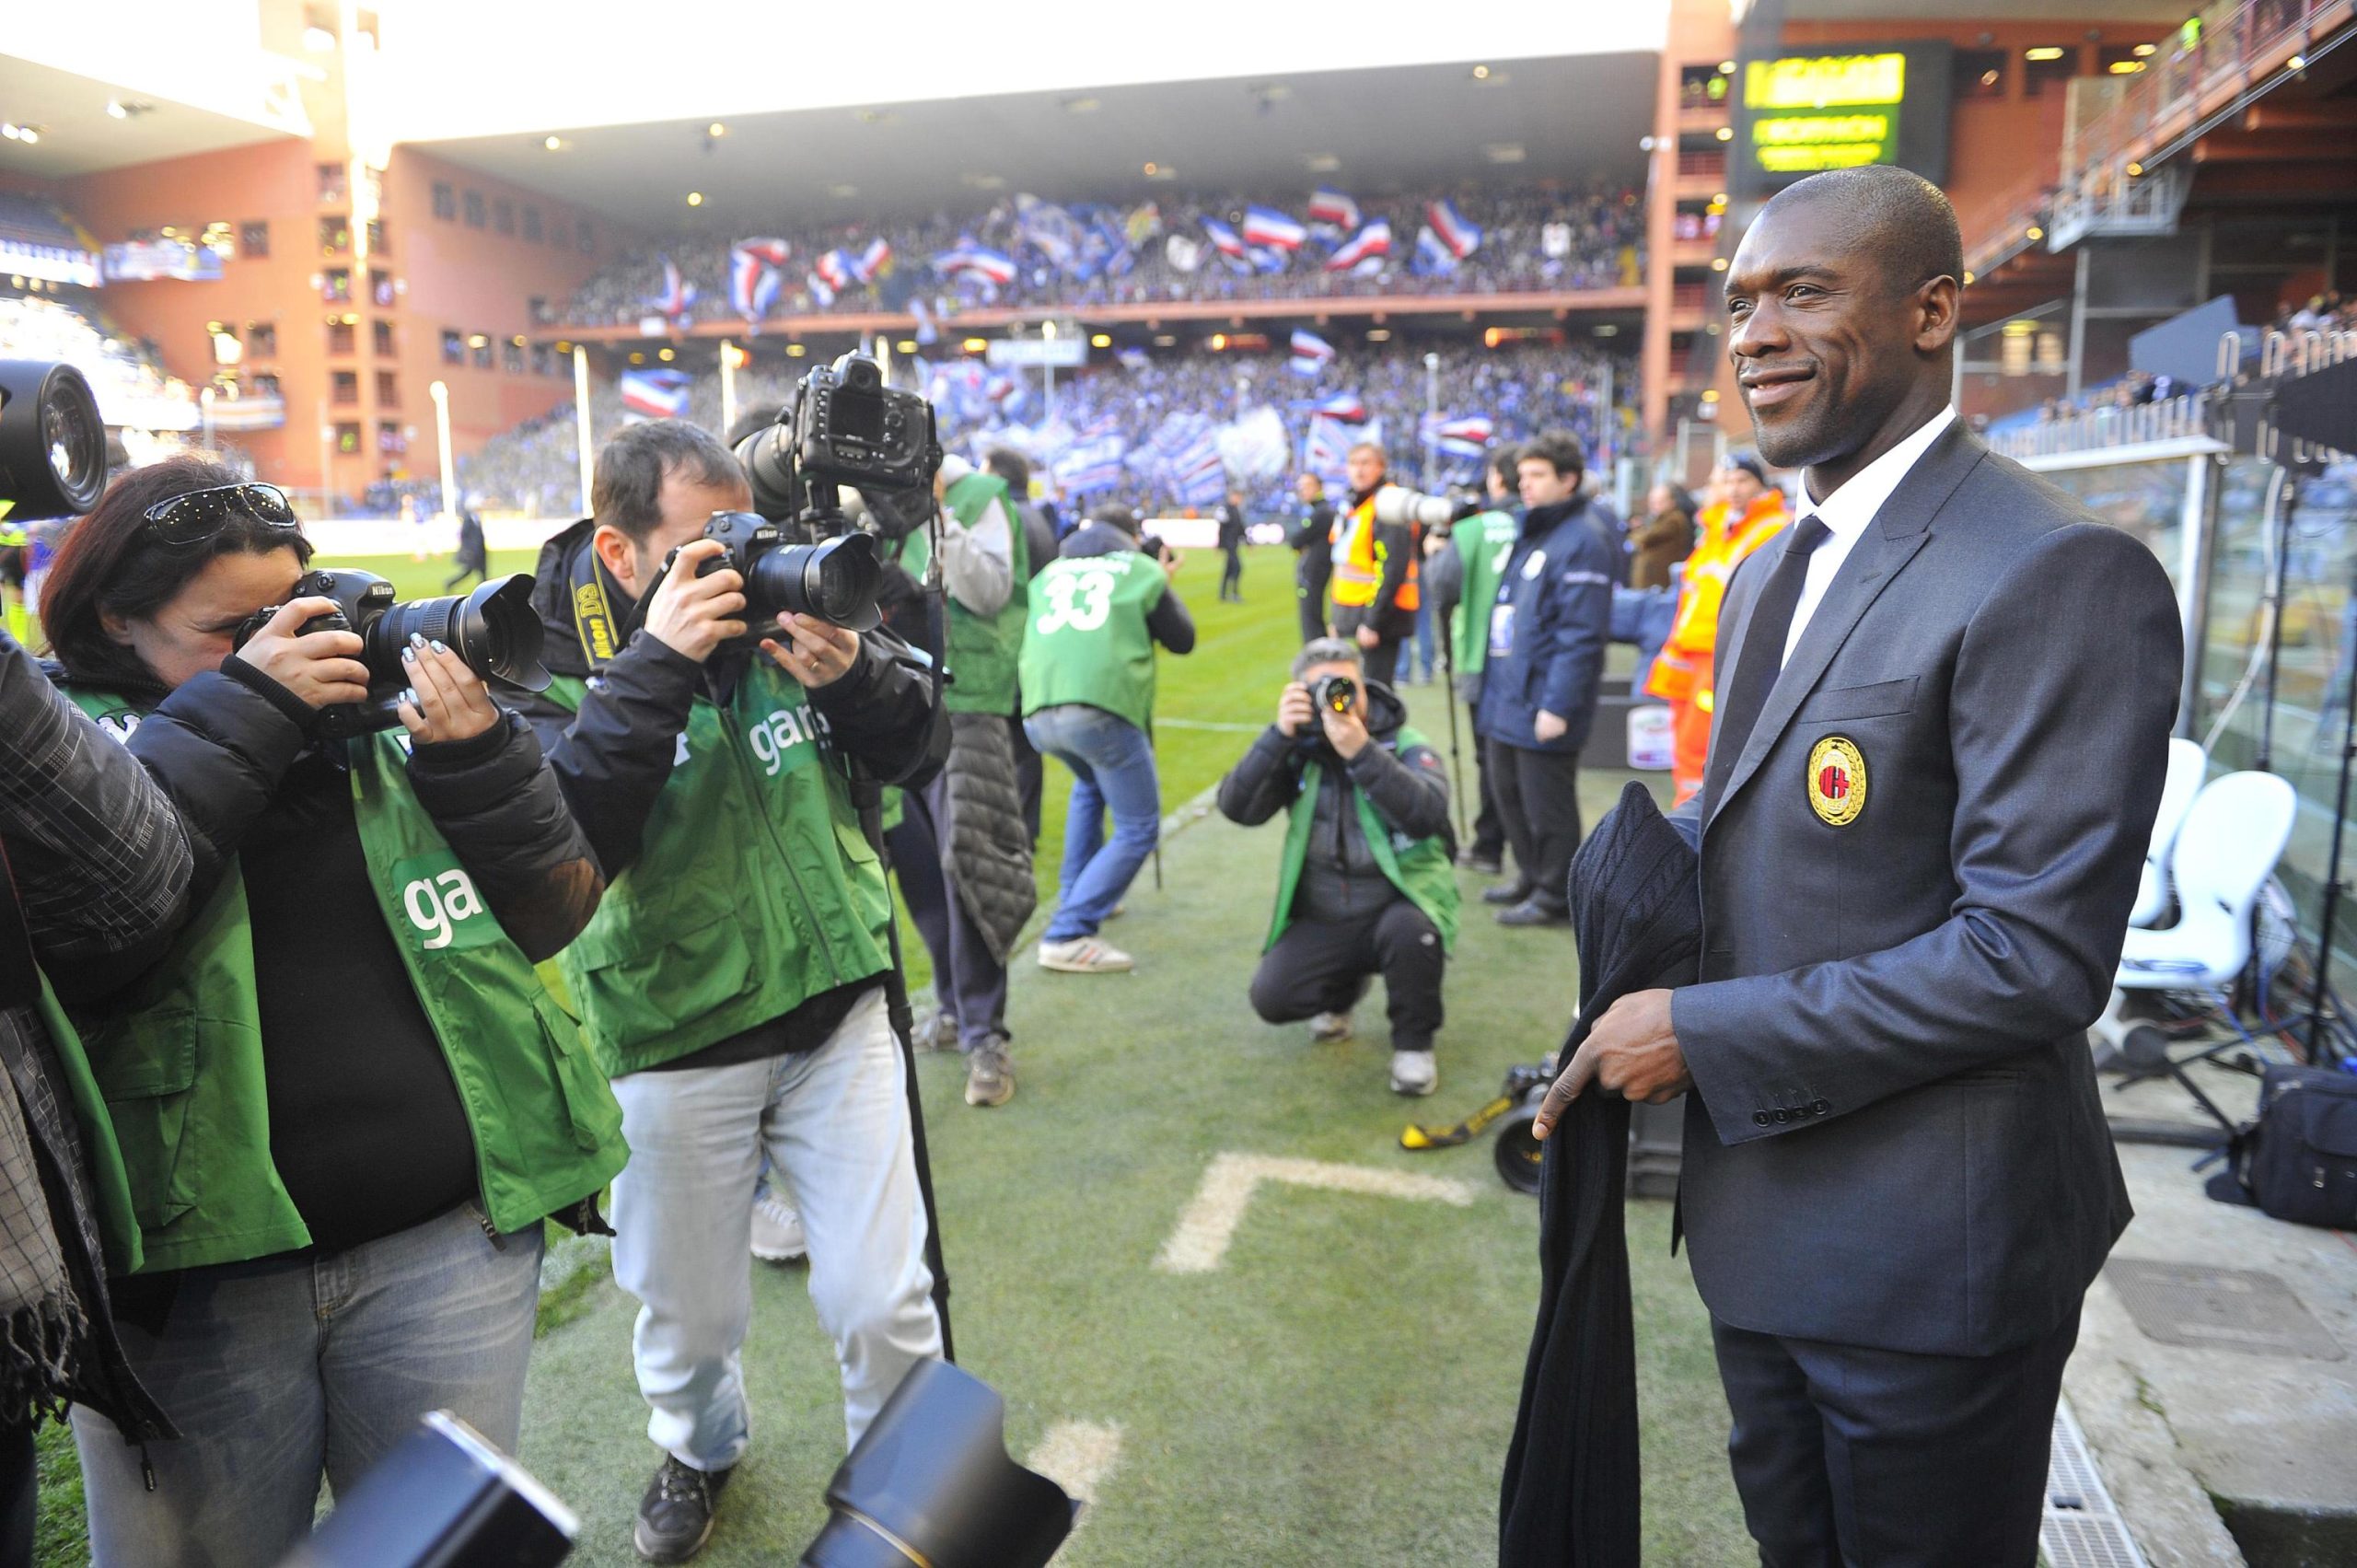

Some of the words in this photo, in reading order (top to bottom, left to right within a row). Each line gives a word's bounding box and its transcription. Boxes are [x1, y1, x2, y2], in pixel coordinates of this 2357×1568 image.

[757, 528, 778, 540] Nikon
[371, 585, 393, 596] Nikon
[1037, 570, 1115, 634] 33
[589, 618, 614, 659] Nikon
